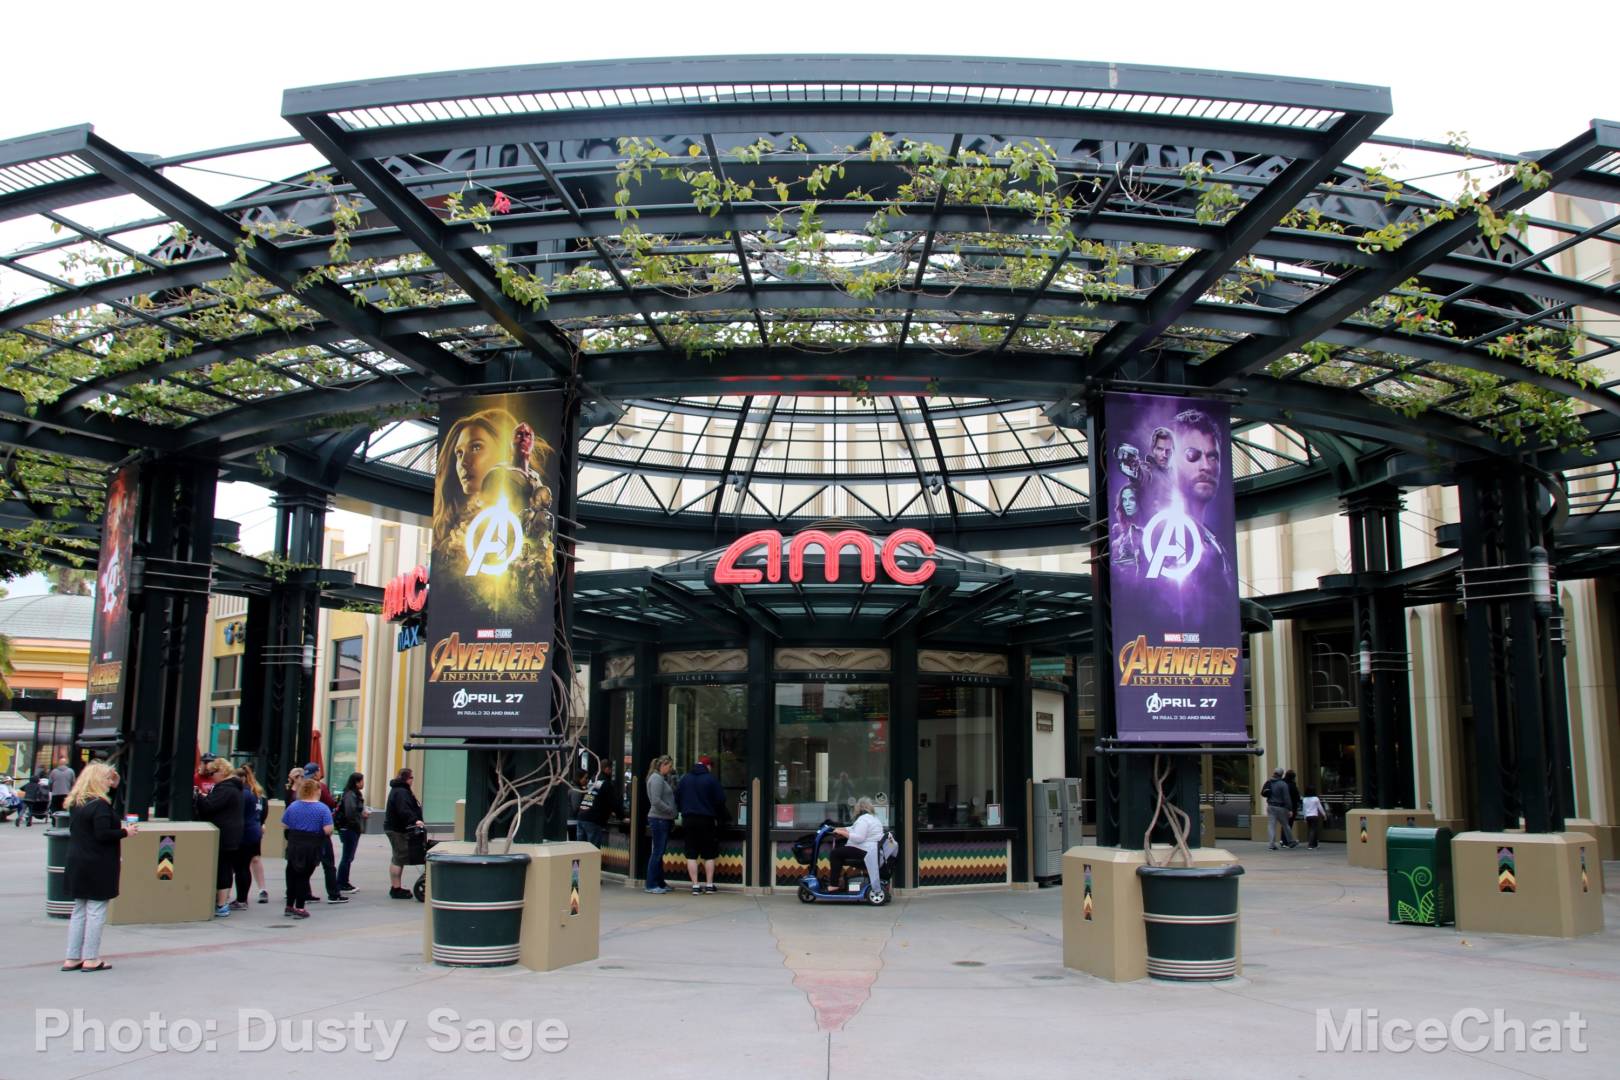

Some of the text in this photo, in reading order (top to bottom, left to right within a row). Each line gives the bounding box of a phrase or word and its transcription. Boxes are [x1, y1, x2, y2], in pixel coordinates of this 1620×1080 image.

[429, 632, 549, 682] AVENGERS
[1119, 635, 1239, 686] AVENGERS
[443, 672, 538, 681] INFINITY WAR
[1134, 676, 1231, 685] INFINITY WAR
[452, 688, 524, 708] APRIL 27
[1146, 693, 1218, 713] APRIL 27
